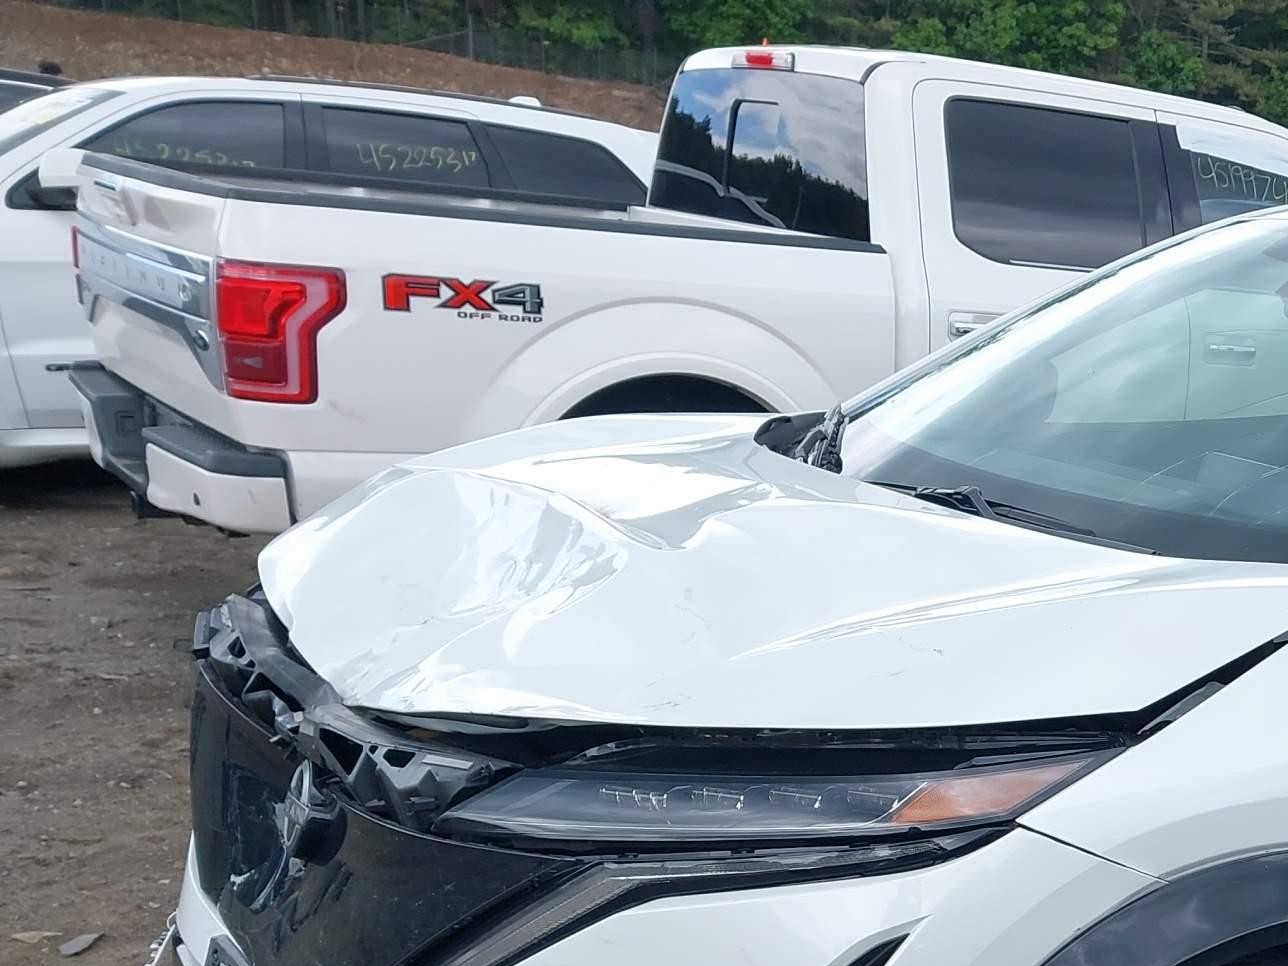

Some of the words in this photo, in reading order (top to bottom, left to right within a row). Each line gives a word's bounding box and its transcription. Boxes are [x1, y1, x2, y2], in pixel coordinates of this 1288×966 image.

[382, 273, 544, 314] FX4
[457, 311, 491, 319] OFF
[498, 314, 543, 323] ROAD
